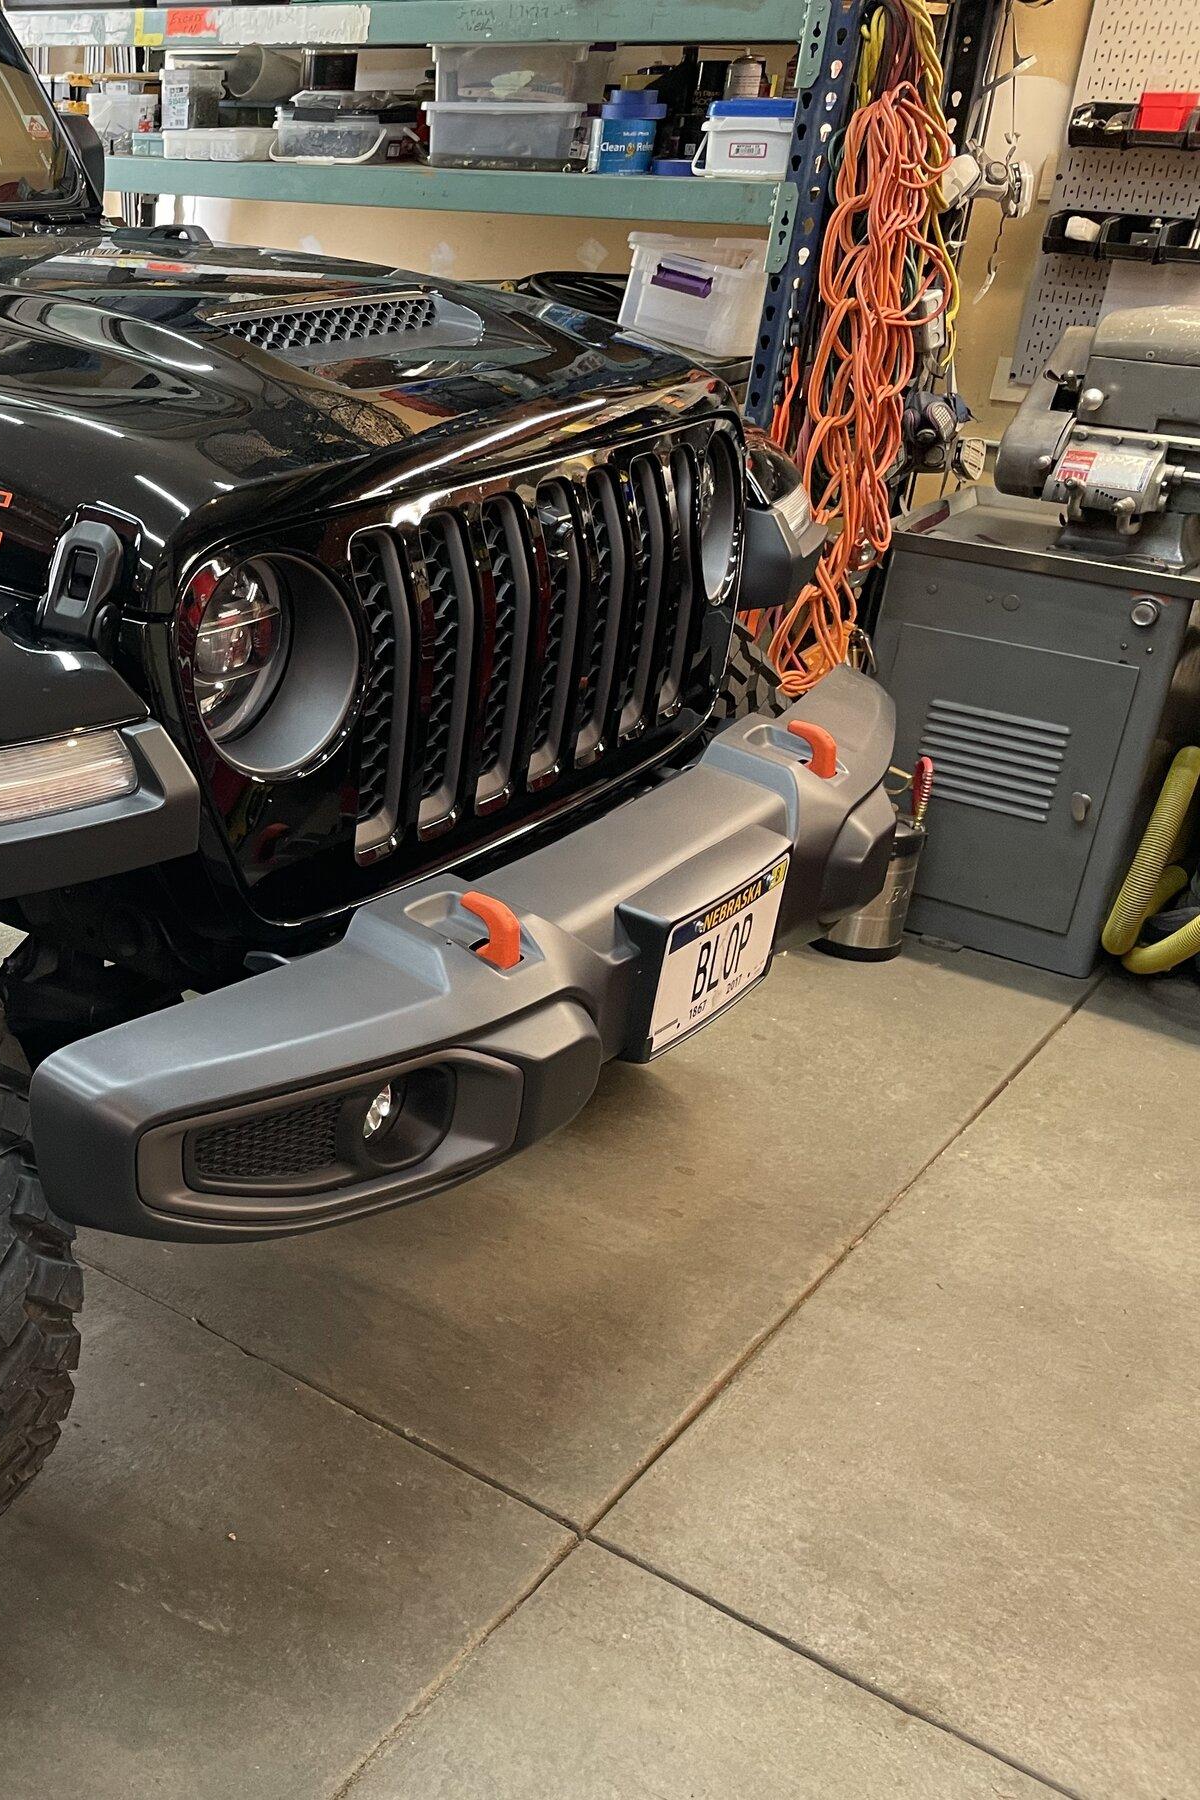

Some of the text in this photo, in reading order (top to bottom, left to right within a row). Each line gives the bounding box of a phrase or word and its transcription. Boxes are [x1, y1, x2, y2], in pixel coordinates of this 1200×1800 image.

[600, 141, 625, 152] Clean
[703, 880, 762, 933] NEBRASKA
[689, 973, 743, 1019] 1867 2017
